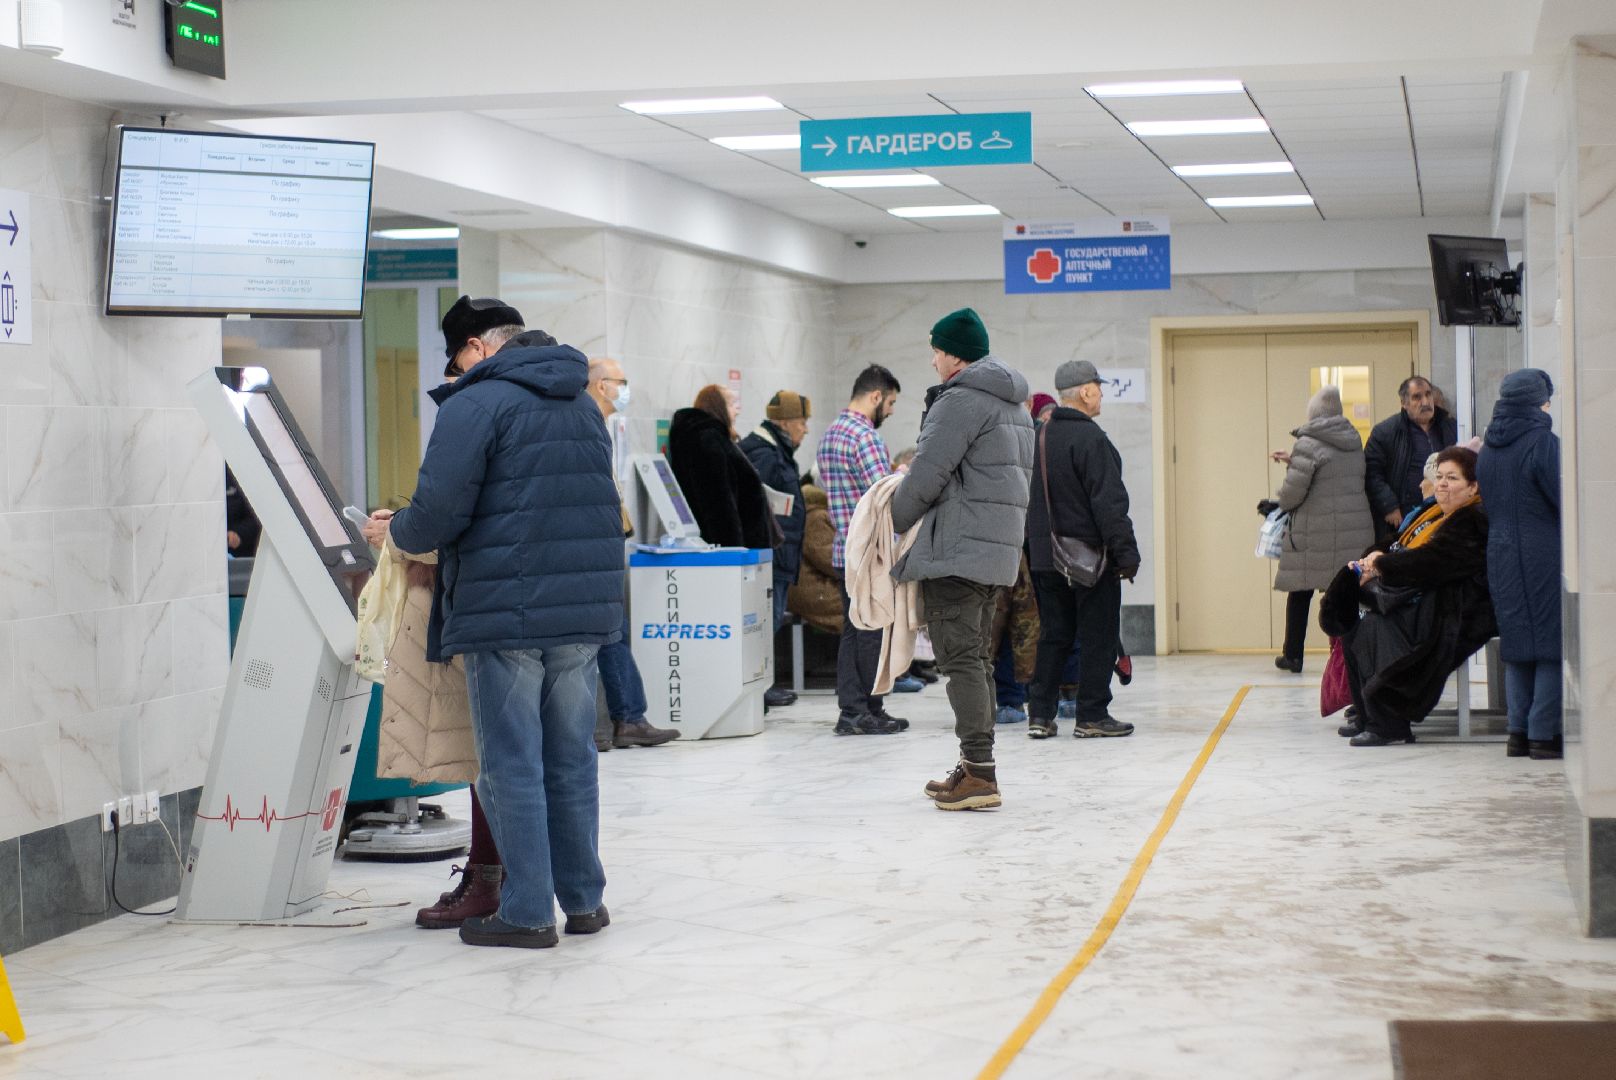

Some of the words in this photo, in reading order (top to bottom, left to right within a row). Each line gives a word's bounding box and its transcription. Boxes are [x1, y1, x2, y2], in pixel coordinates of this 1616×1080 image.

[847, 132, 973, 155] ГАРДЕРОБ
[1065, 244, 1148, 258] ГОСУДАРСТВЕННЫЙ
[1065, 259, 1112, 271] АПТЕЧНЫЙ
[1065, 272, 1093, 283] ПУНКТ
[642, 624, 731, 639] EXPRESS
